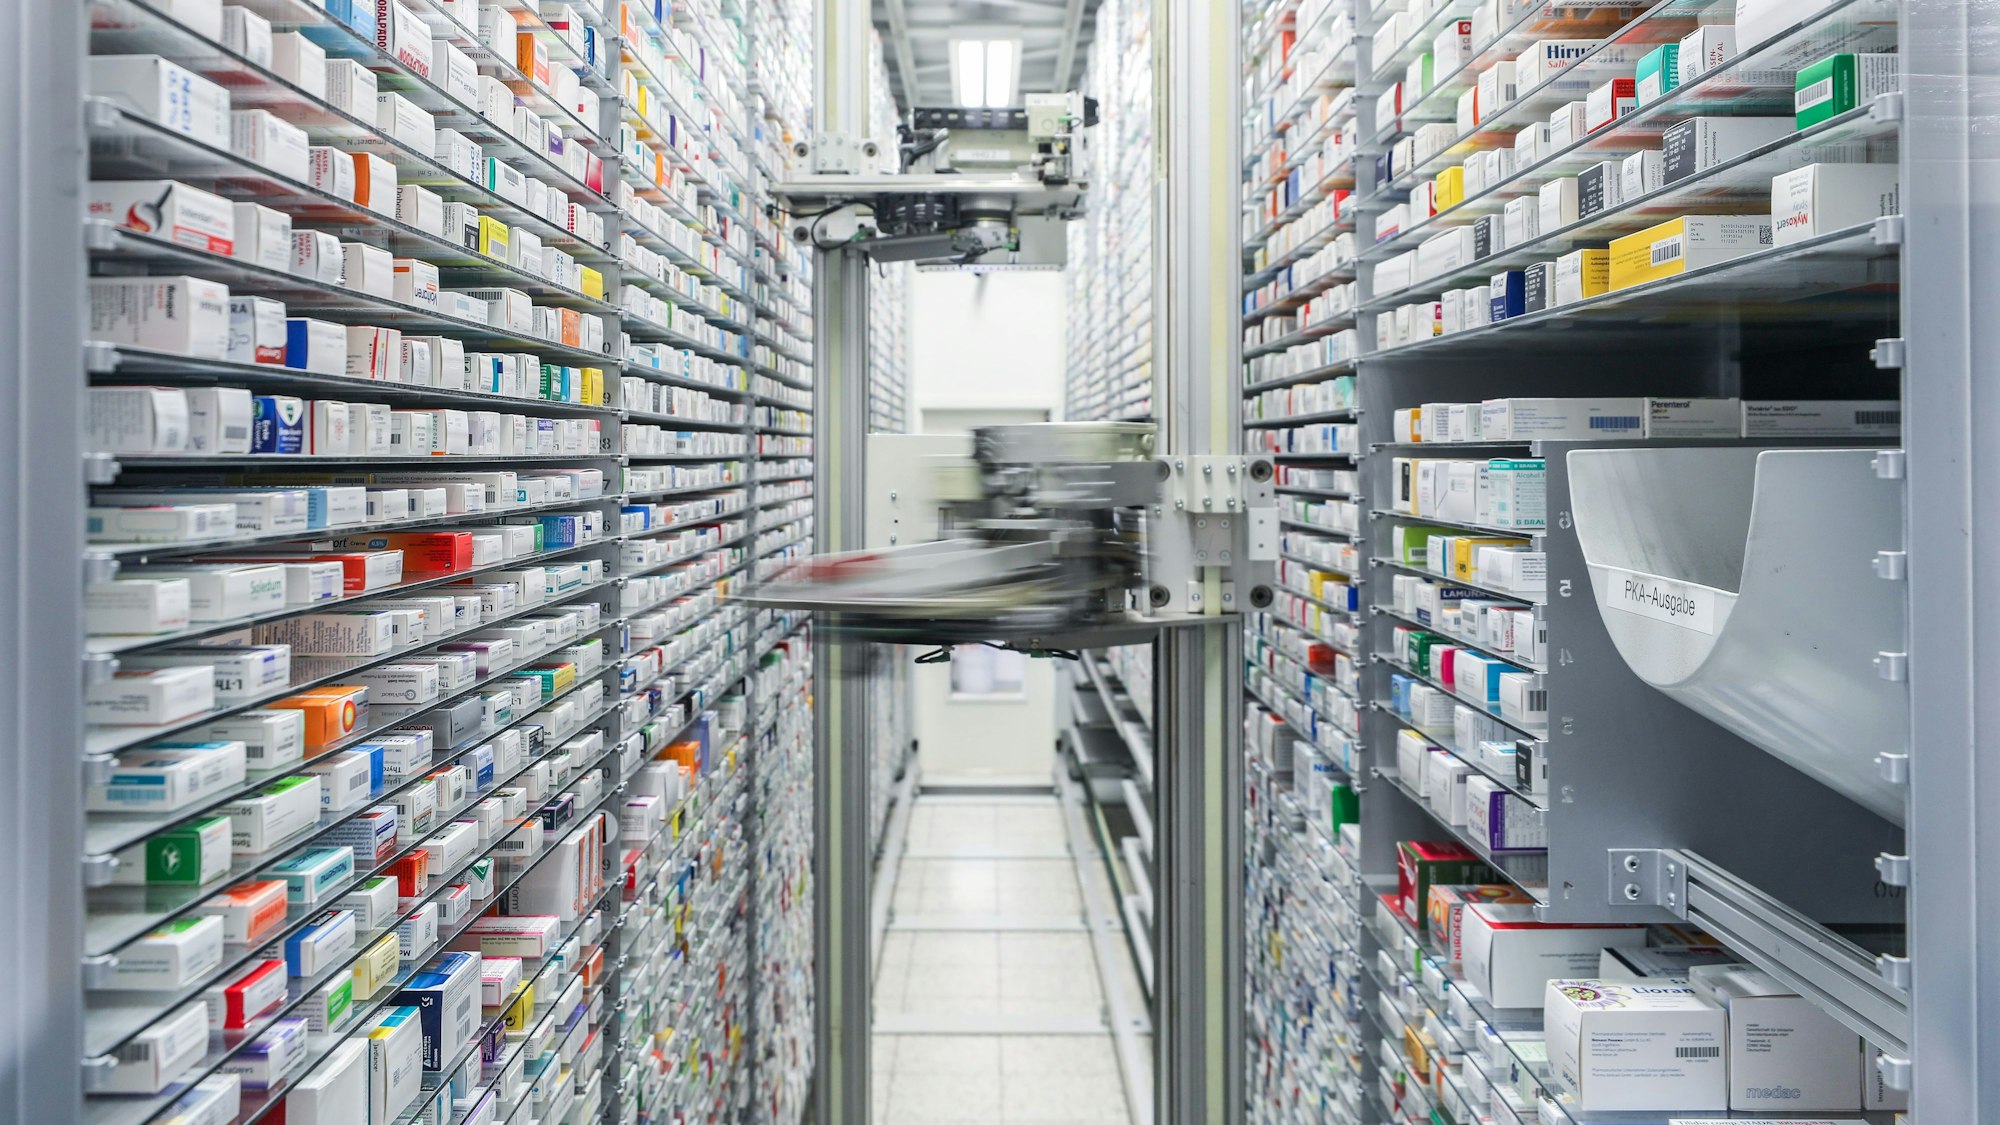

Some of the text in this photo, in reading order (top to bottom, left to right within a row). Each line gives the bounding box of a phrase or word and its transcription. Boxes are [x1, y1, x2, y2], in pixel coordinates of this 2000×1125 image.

[1776, 212, 1809, 232] Mykosert
[415, 287, 437, 306] Voltaren
[1651, 401, 1690, 409] Perenterol
[250, 580, 282, 593] Soledum
[1625, 579, 1696, 616] PKA-Ausgabe
[1453, 907, 1463, 960] NUROFEN
[1631, 986, 1696, 995] Lioran
[1746, 1086, 1801, 1099] medac
